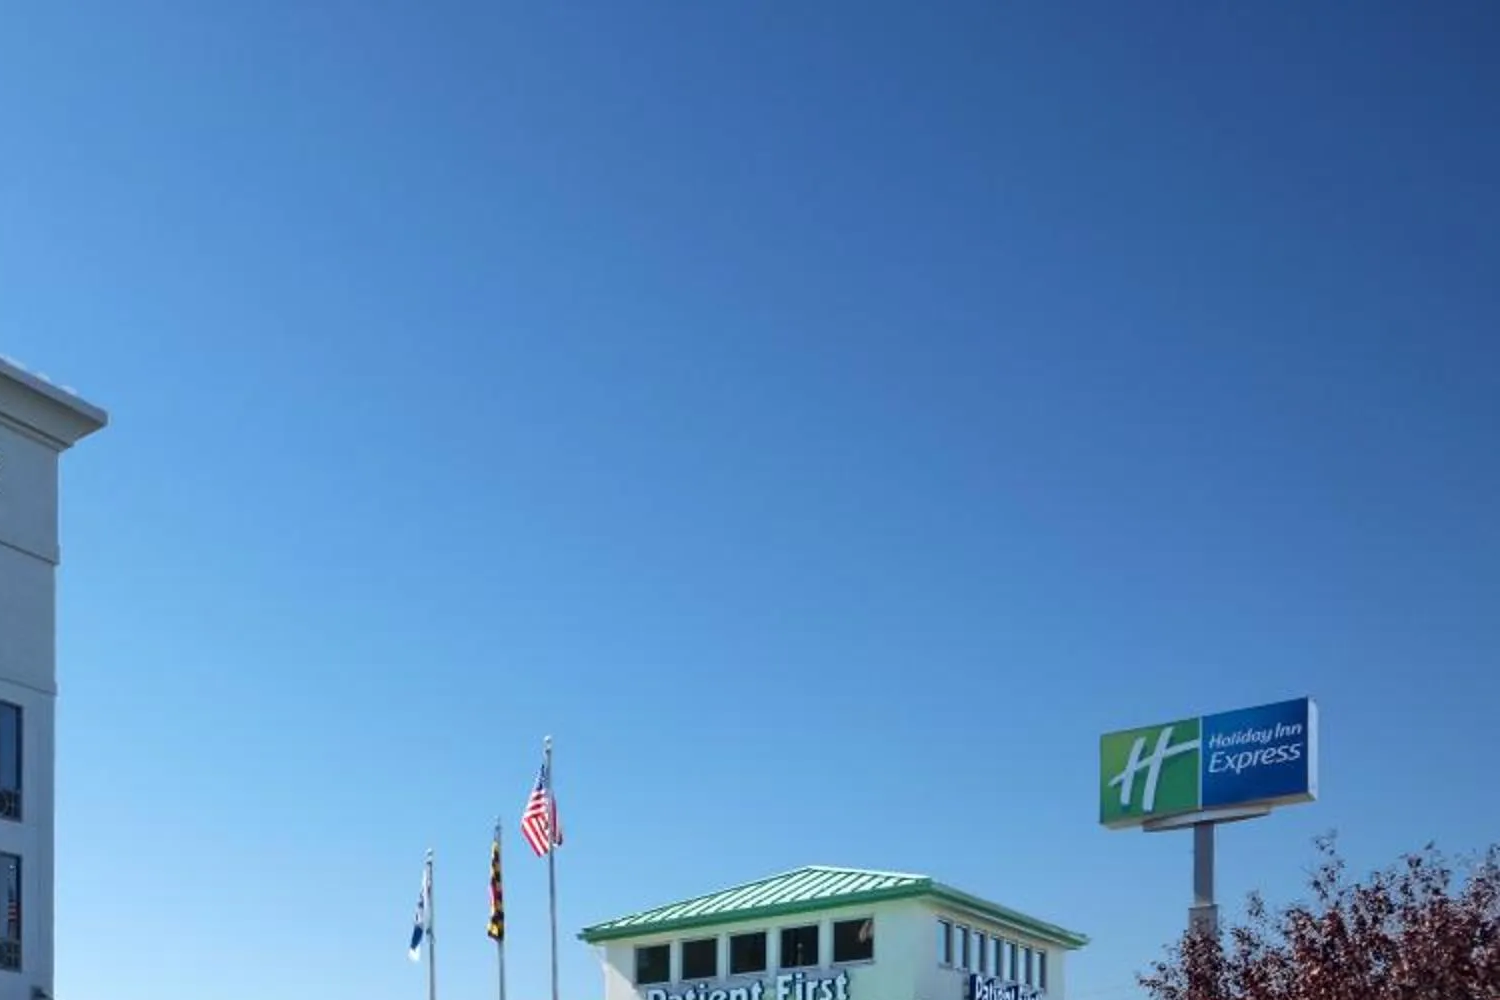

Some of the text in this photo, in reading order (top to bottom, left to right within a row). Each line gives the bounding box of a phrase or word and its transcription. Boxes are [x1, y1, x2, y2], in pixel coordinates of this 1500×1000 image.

[1208, 721, 1302, 749] Holiday Inn
[1208, 742, 1302, 775] Express
